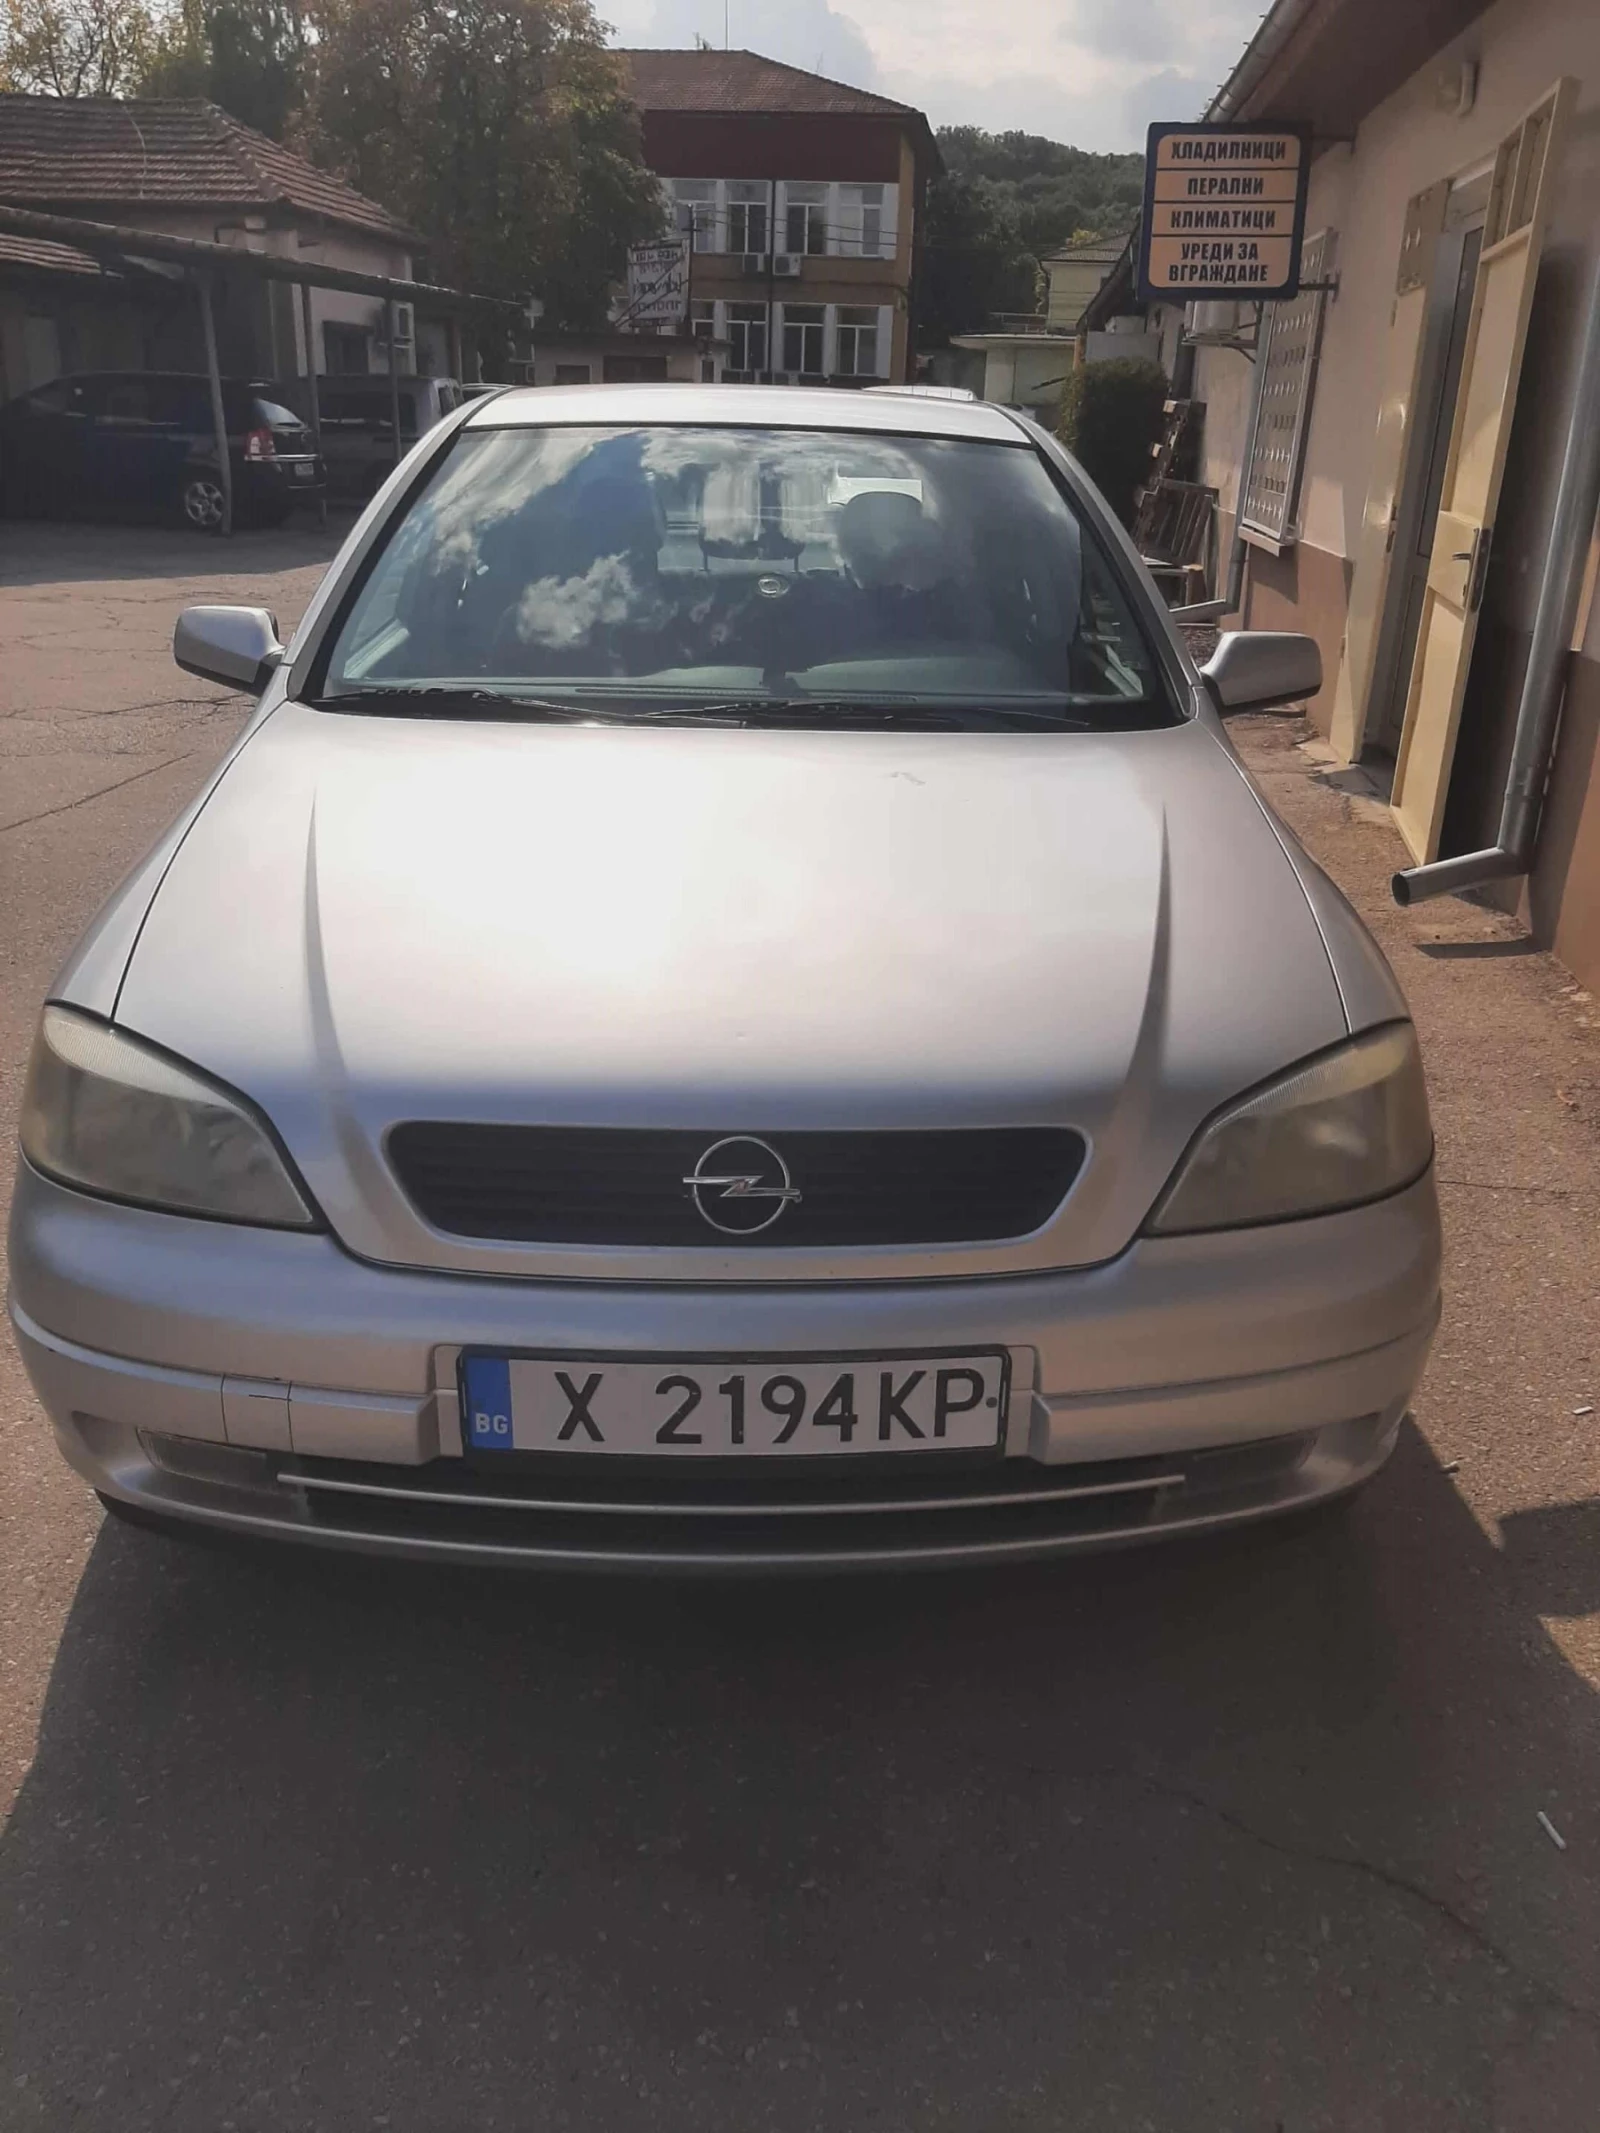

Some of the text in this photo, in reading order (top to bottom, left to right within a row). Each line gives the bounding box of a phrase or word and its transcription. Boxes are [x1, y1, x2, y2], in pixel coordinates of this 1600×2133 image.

[1171, 141, 1287, 162] ХЛАДИЛНИЦИ
[1187, 177, 1264, 196] ПЕРАЛНИ
[1171, 210, 1276, 229] КЛИМАТИЦИ
[1181, 243, 1259, 262] УРЕДИ ЗА
[1168, 264, 1269, 284] ВГРАЖДАНЕ
[475, 1412, 509, 1434] BG
